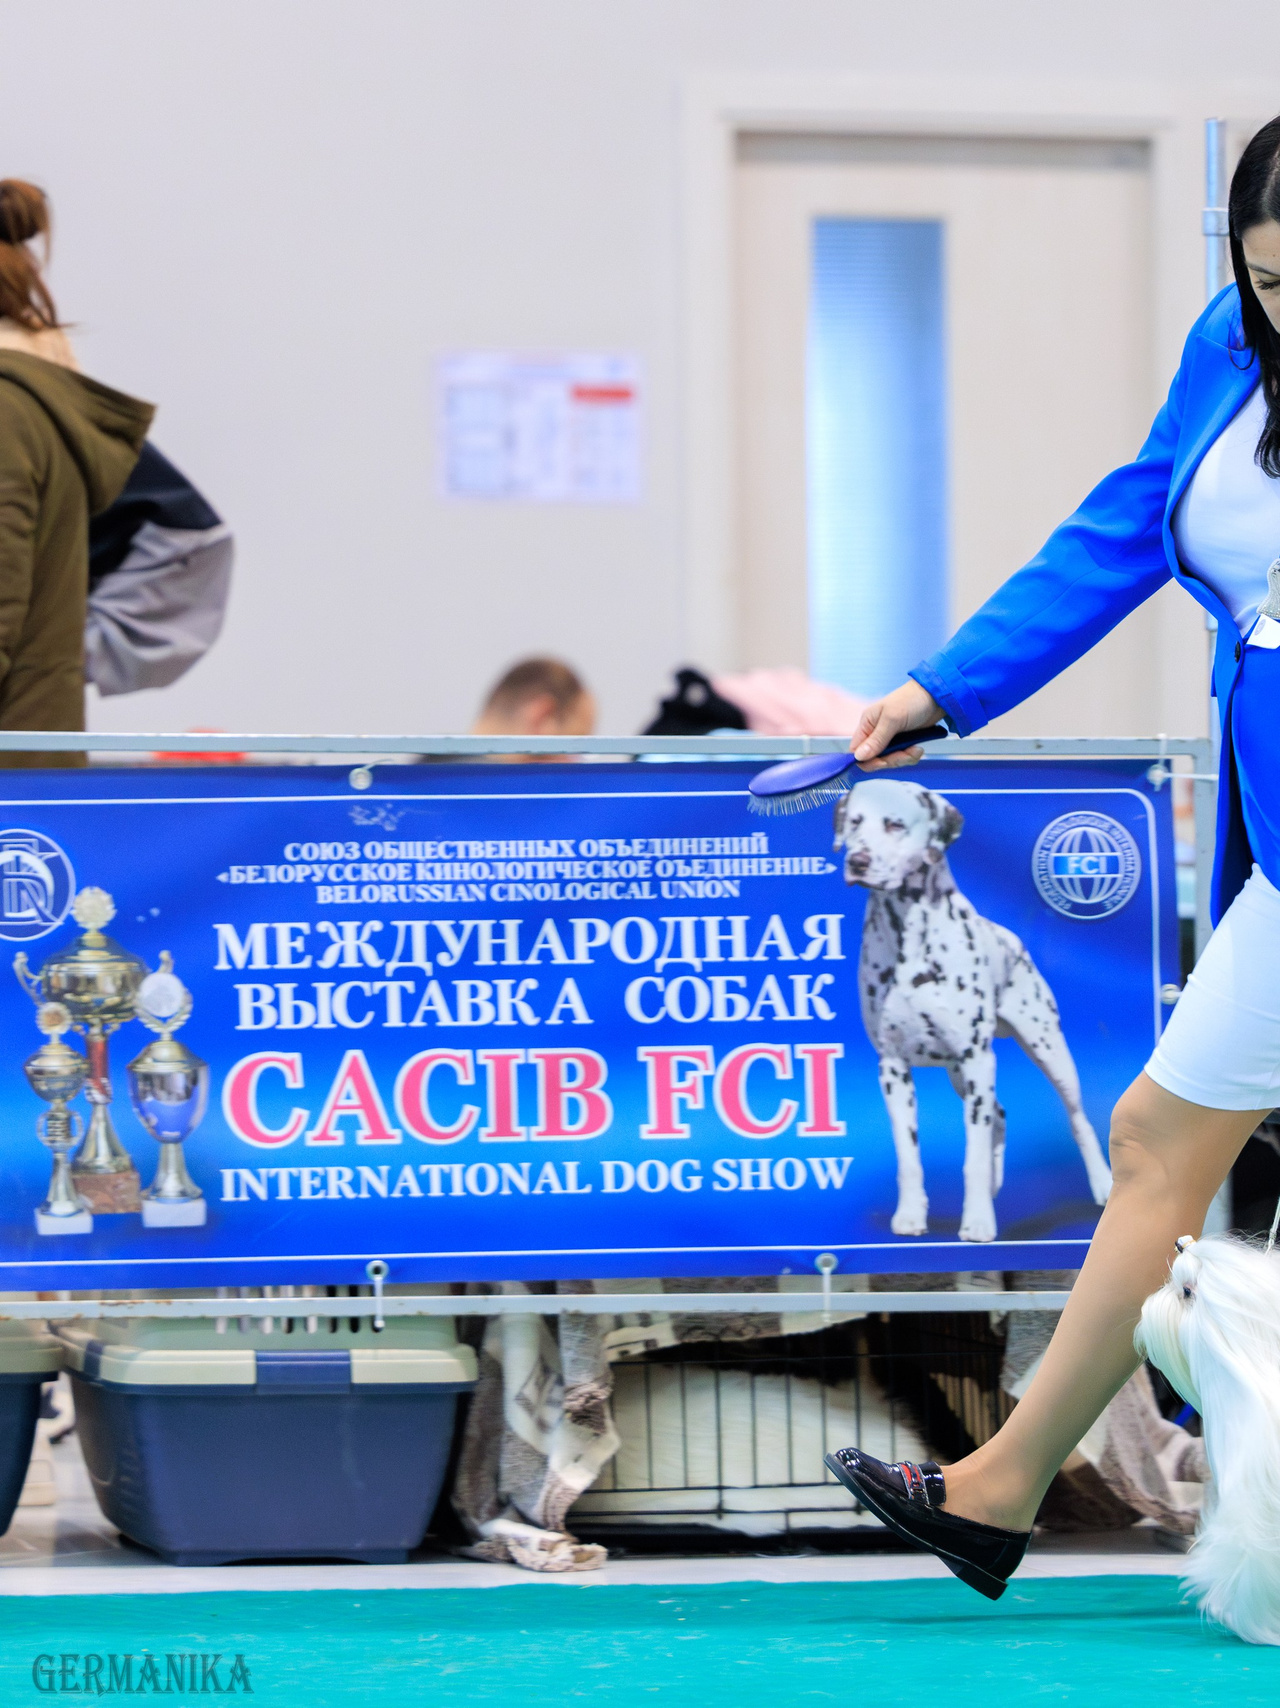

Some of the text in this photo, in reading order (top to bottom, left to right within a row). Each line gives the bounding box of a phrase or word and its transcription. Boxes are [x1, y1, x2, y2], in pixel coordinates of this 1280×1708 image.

[283, 832, 770, 862] СОЮЗ ОБЩЕСТВЕННЫХ ОБЪЕДИНЕНИЙ
[1067, 855, 1108, 875] FCI
[415, 859, 652, 882] КИНОЛОГИЧЕСКОЕ
[316, 879, 741, 904] BELORUSSIAN CINOLOGICAL UNION
[213, 914, 846, 978] МЕЖДУНАРОДНАЯ
[234, 974, 836, 1030] ВЫСТАВКА СОБАК
[222, 1043, 847, 1149] CACIB FCI
[220, 1156, 854, 1202] INTERNATIONAL DOG SHOW
